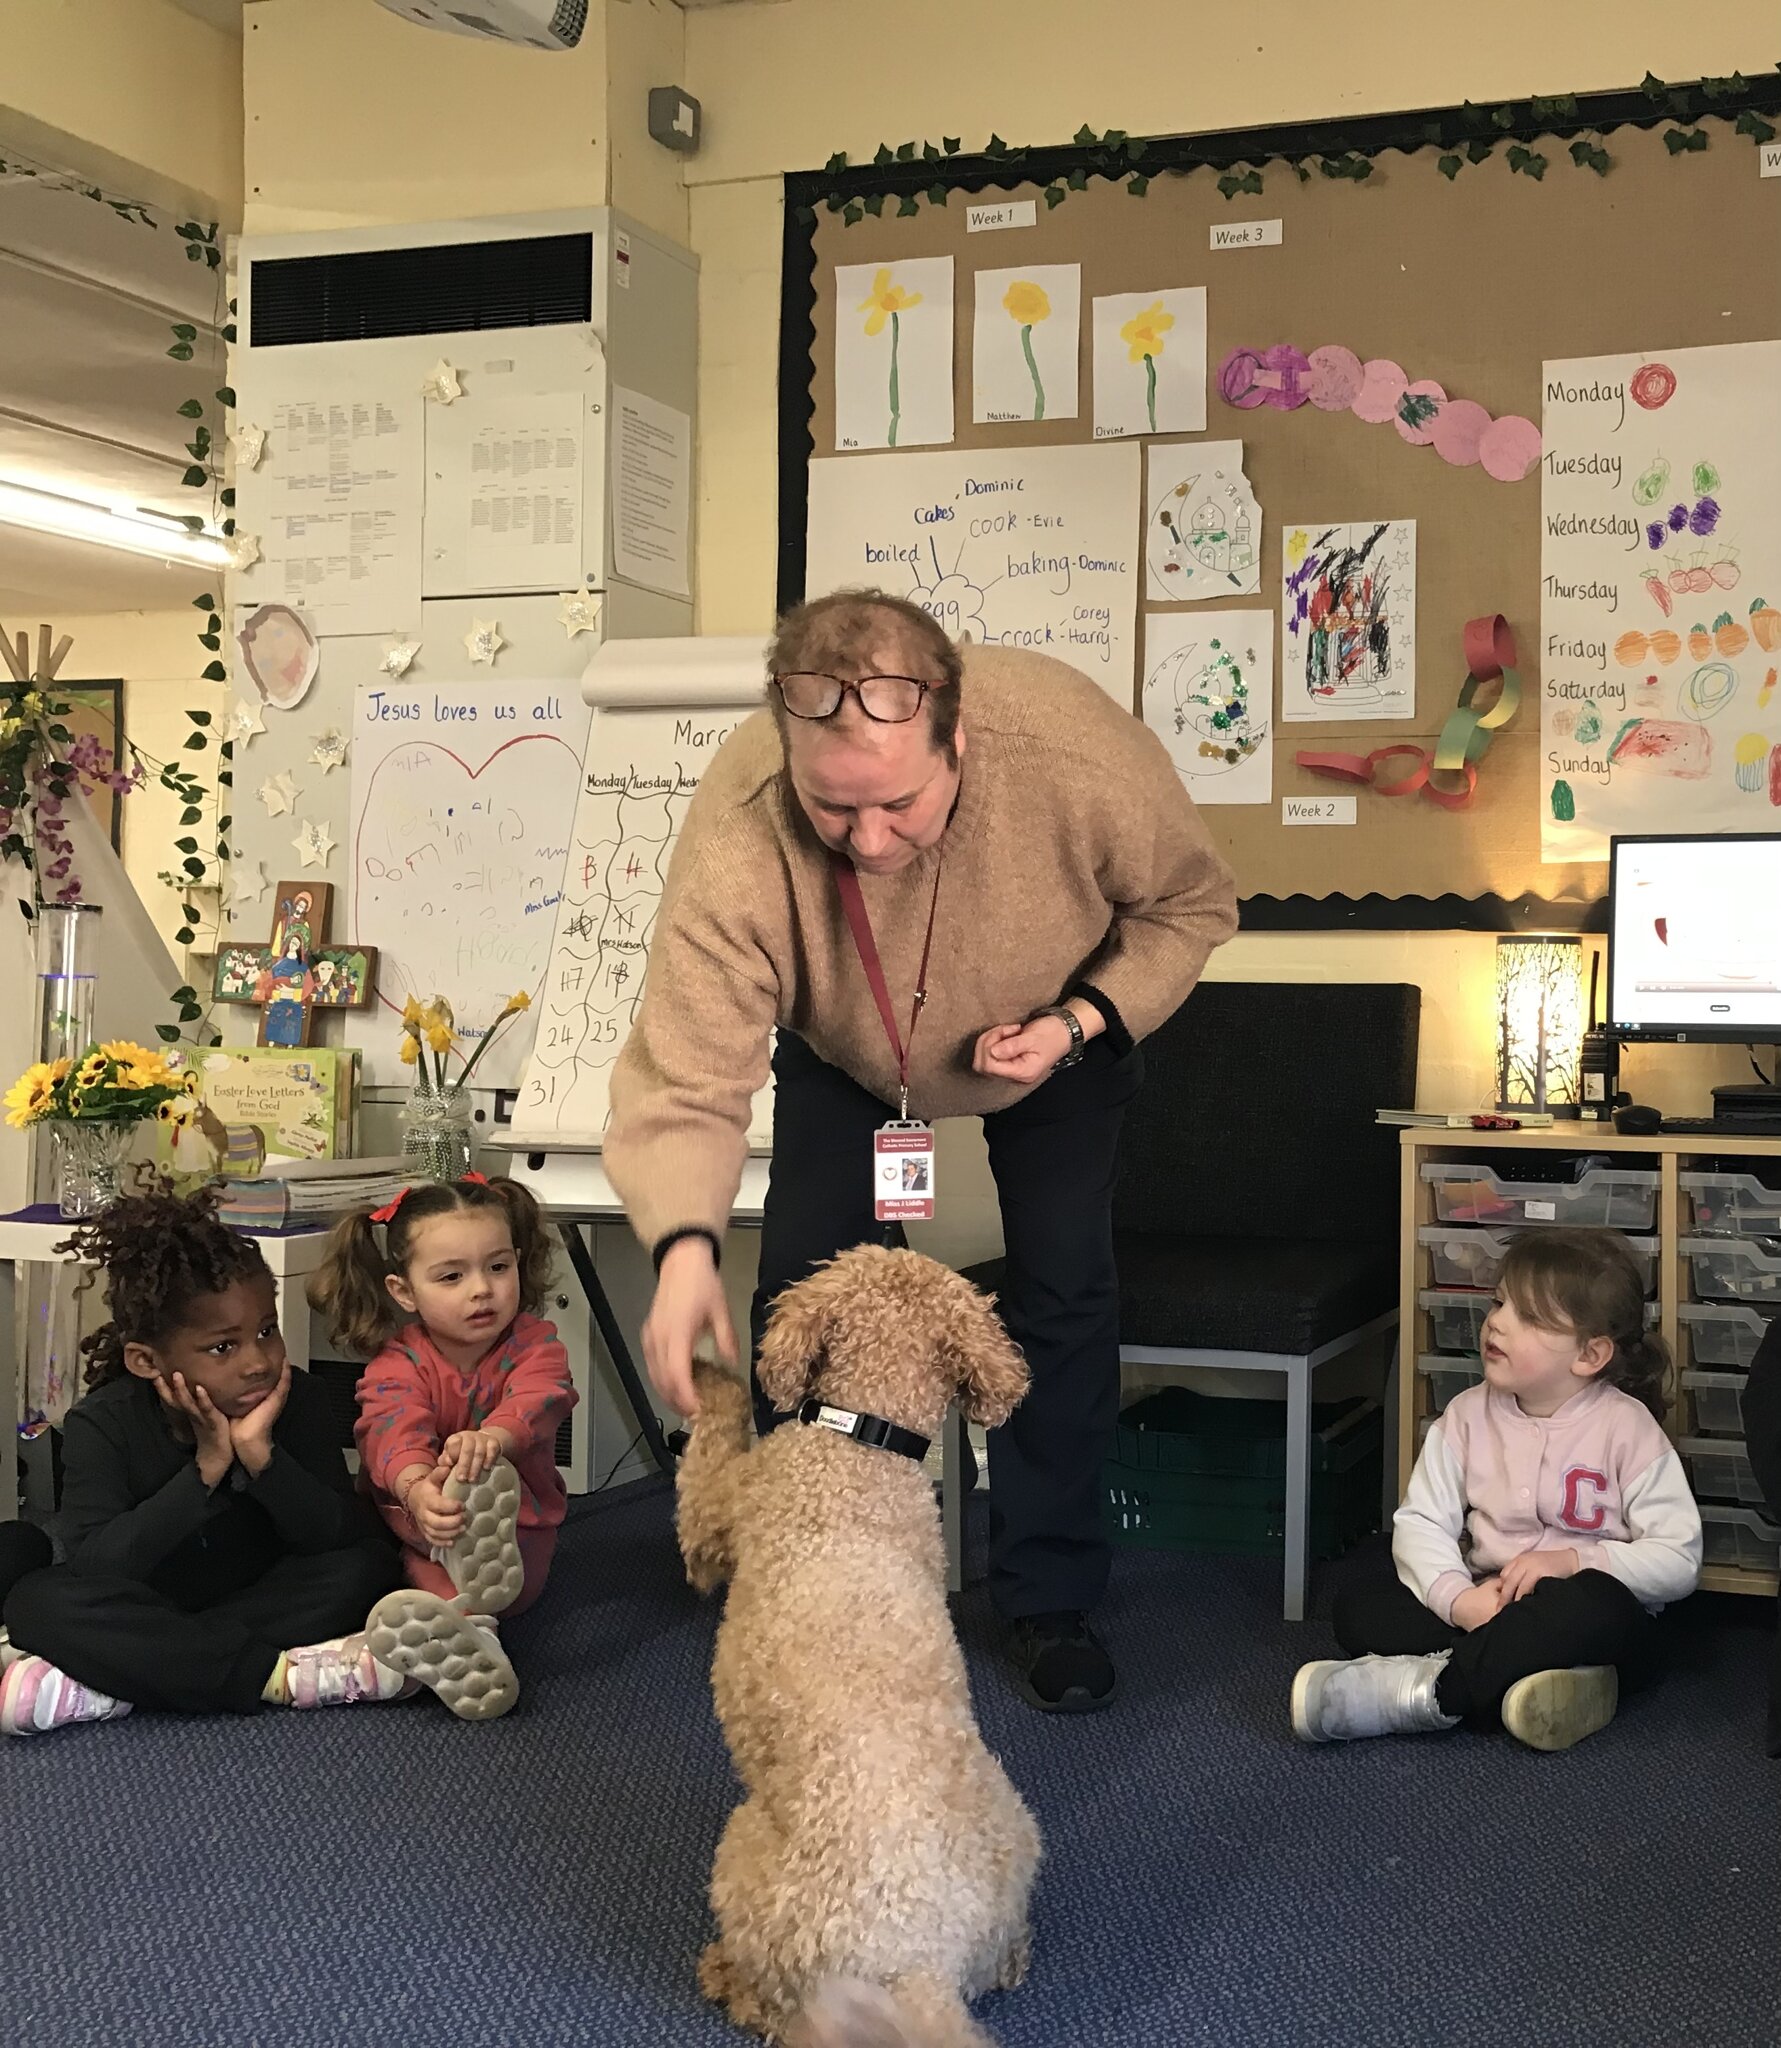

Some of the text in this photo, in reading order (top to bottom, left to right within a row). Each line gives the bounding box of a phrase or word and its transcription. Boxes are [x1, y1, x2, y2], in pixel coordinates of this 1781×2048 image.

[971, 208, 1014, 226] Week 1
[1216, 228, 1263, 245] Week 3
[986, 411, 1022, 421] Matthew
[1547, 381, 1625, 433] Monday
[842, 437, 859, 448] Mia
[1095, 425, 1124, 437] Divine
[1544, 450, 1622, 489] Tuesday
[965, 478, 1024, 496] Dominic
[1547, 513, 1640, 552] Wednesday
[866, 542, 921, 563] boiled
[1543, 575, 1618, 613] Thursday
[921, 600, 960, 631] egg
[1073, 605, 1110, 629] Corey
[1001, 623, 1054, 648] crack
[1548, 634, 1607, 670] Friday
[1547, 678, 1627, 711] Saturday
[366, 692, 563, 722] Jesus loves us all
[674, 719, 738, 748] Marc
[1548, 751, 1611, 786] Sunday
[587, 773, 627, 793] Monday
[632, 774, 672, 793] Tuesday
[1286, 803, 1336, 817] Week 2
[601, 938, 616, 948] Mrs
[457, 1025, 488, 1039] Watso
[547, 1018, 618, 1047] 24 25
[213, 1084, 305, 1098] Easter Love Letters
[529, 1076, 556, 1107] 31
[236, 1099, 280, 1111] from God
[1560, 1465, 1608, 1531] C
